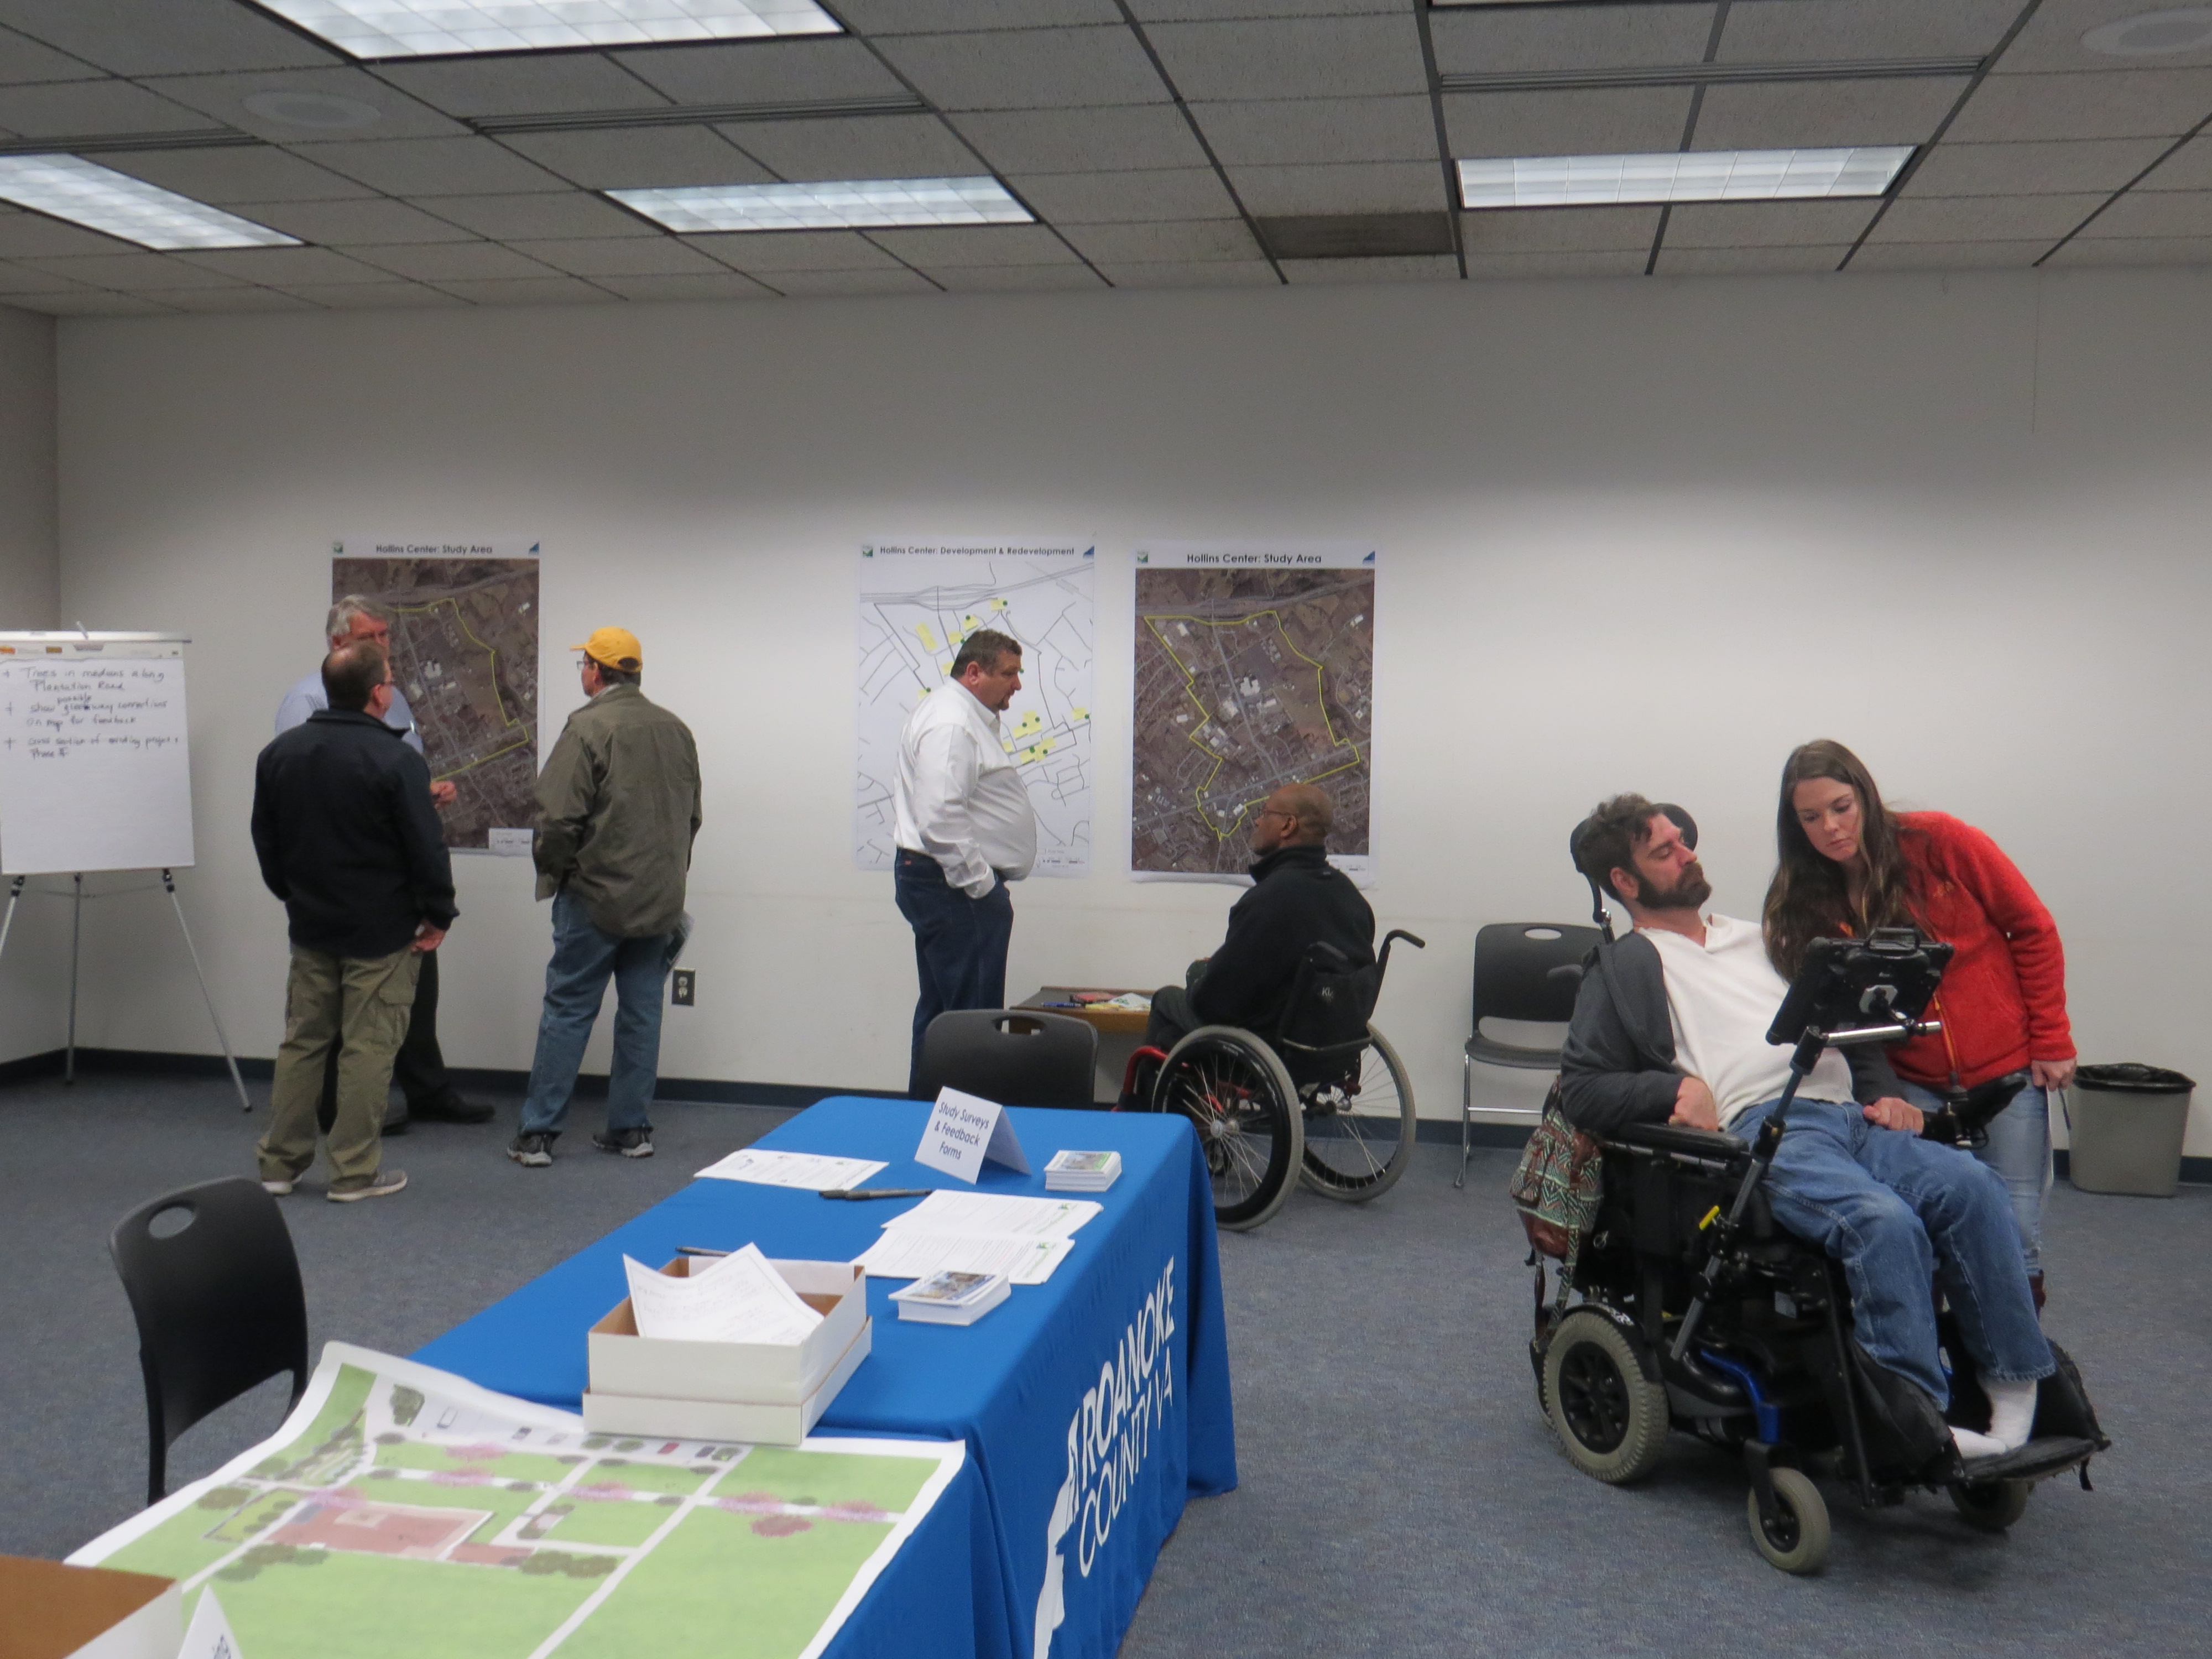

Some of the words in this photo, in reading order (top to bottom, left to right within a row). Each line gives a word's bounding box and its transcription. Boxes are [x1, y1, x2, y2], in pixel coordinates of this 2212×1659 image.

[376, 544, 404, 554] Hollins
[407, 544, 440, 554] Center:
[443, 544, 468, 556] Study
[470, 545, 493, 554] Area
[880, 546, 906, 555] Hollins
[908, 546, 938, 555] Center:
[940, 546, 997, 556] Development
[999, 547, 1004, 555] &
[1007, 547, 1074, 557] Redevelopment
[1187, 554, 1219, 564] Hollins
[1223, 554, 1261, 564] Center:
[1264, 554, 1293, 565] Study
[1296, 554, 1322, 564] Area
[29, 679, 92, 691] Plantation
[91, 733, 101, 744] of
[938, 1101, 960, 1120] Study
[960, 1109, 990, 1130] Surveys
[934, 1121, 941, 1131] &
[941, 1122, 981, 1147] Feedback
[939, 1141, 962, 1160] Forms
[1082, 1255, 1175, 1491] ROANOKE
[1079, 1381, 1152, 1577] COUNTY
[1155, 1345, 1173, 1431] VA
